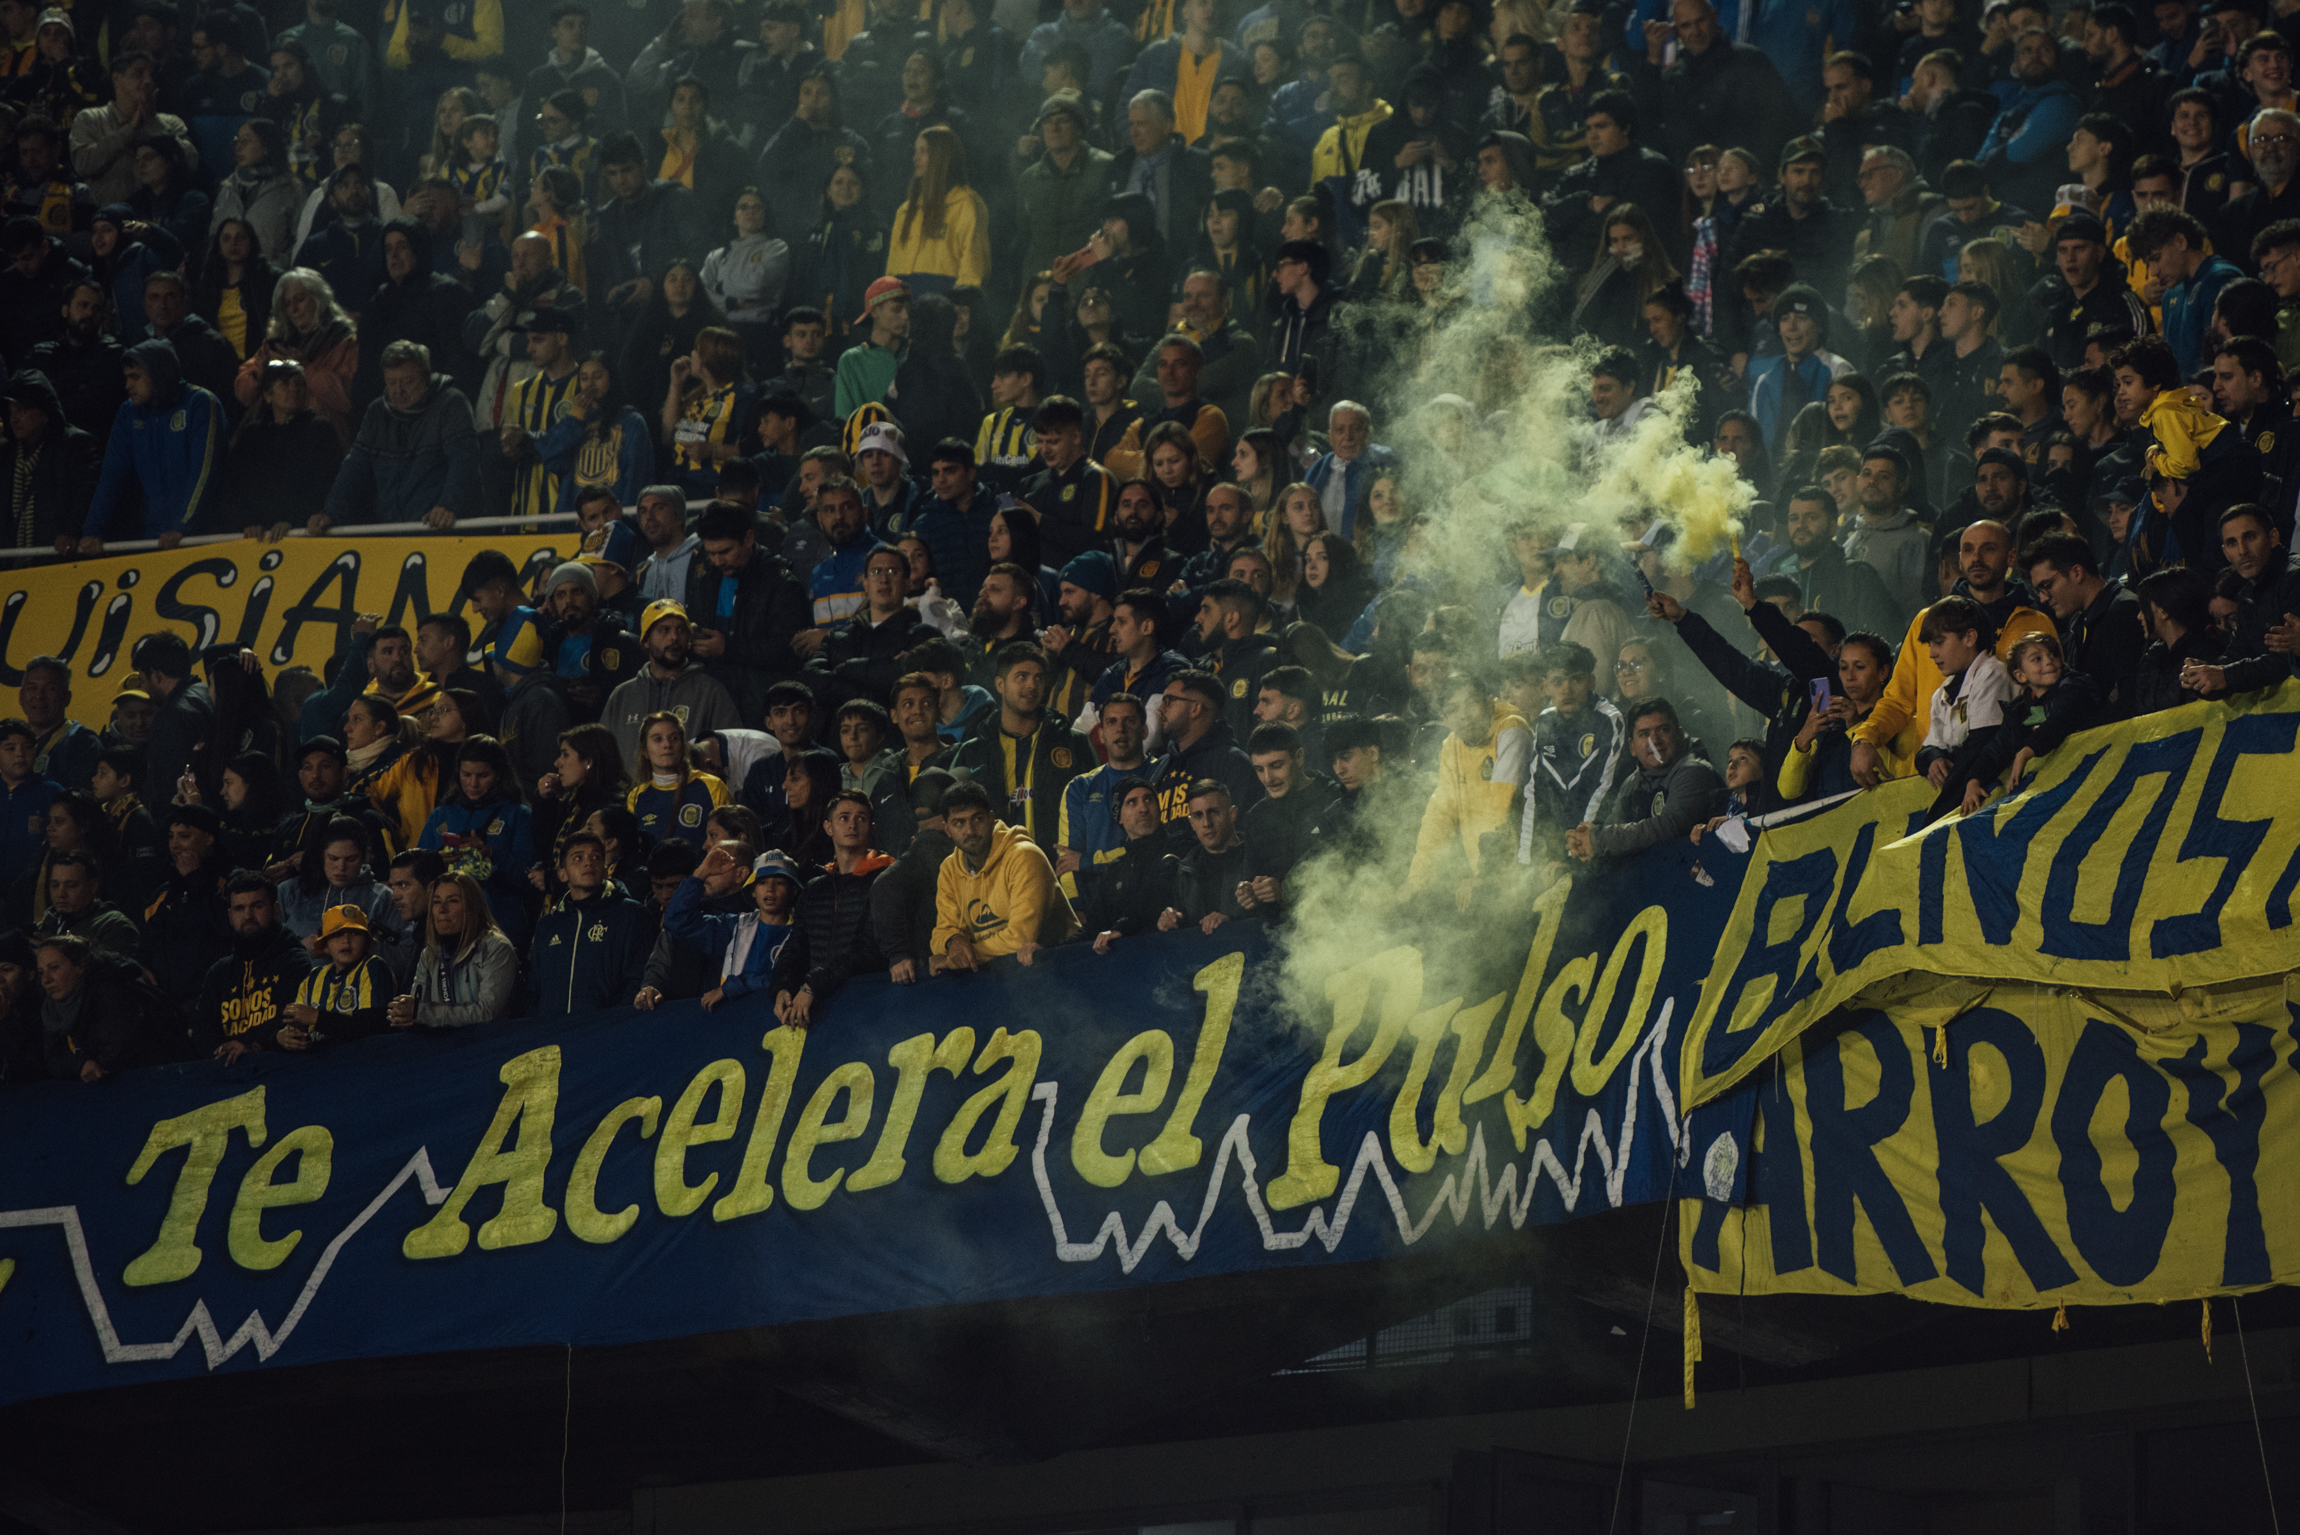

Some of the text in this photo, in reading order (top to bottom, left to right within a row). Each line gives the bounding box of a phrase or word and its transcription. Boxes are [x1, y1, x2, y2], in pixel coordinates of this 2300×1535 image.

[125, 874, 1669, 1286] Te Acelera el Pulso
